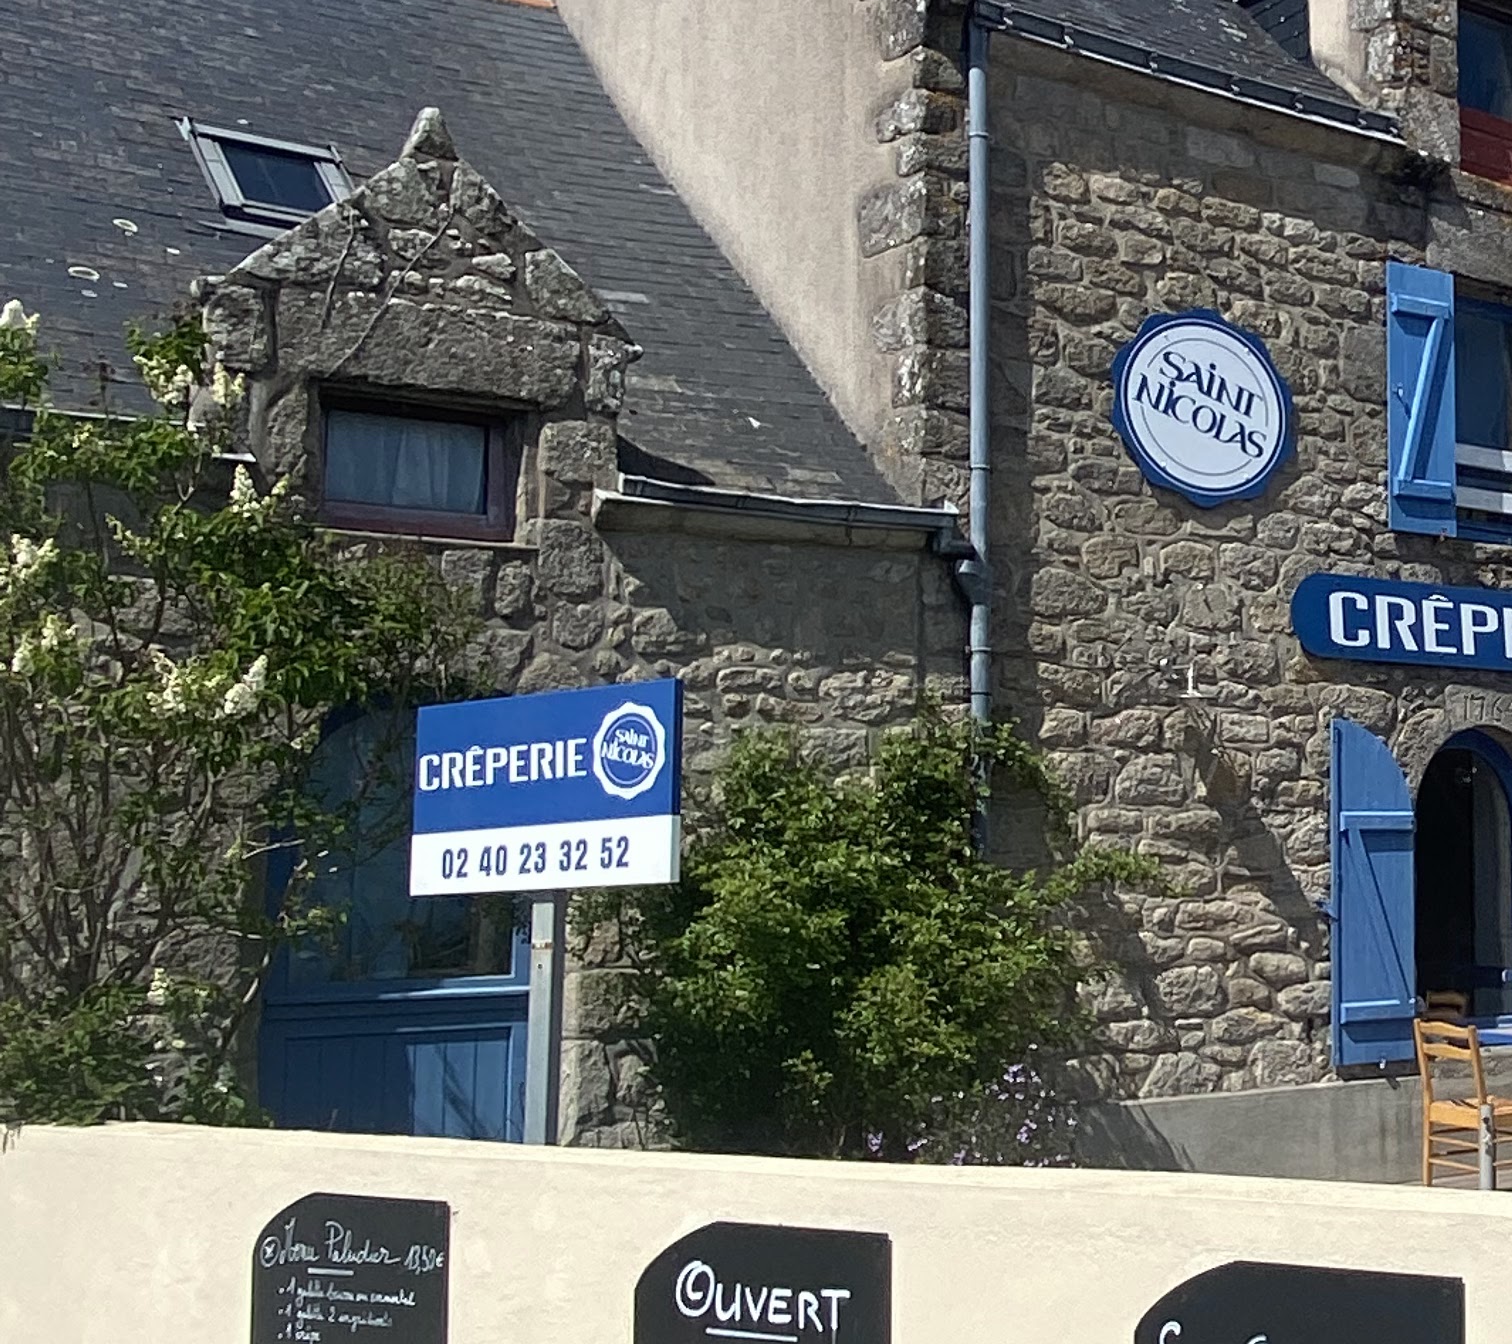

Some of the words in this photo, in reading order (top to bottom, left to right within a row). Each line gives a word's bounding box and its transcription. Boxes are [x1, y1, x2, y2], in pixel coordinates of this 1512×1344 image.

[419, 737, 587, 791] CRÊPERIE
[442, 847, 468, 879] 02
[479, 844, 508, 876] 40
[518, 841, 547, 875] 23
[559, 838, 588, 872] 32
[600, 836, 630, 869] 52
